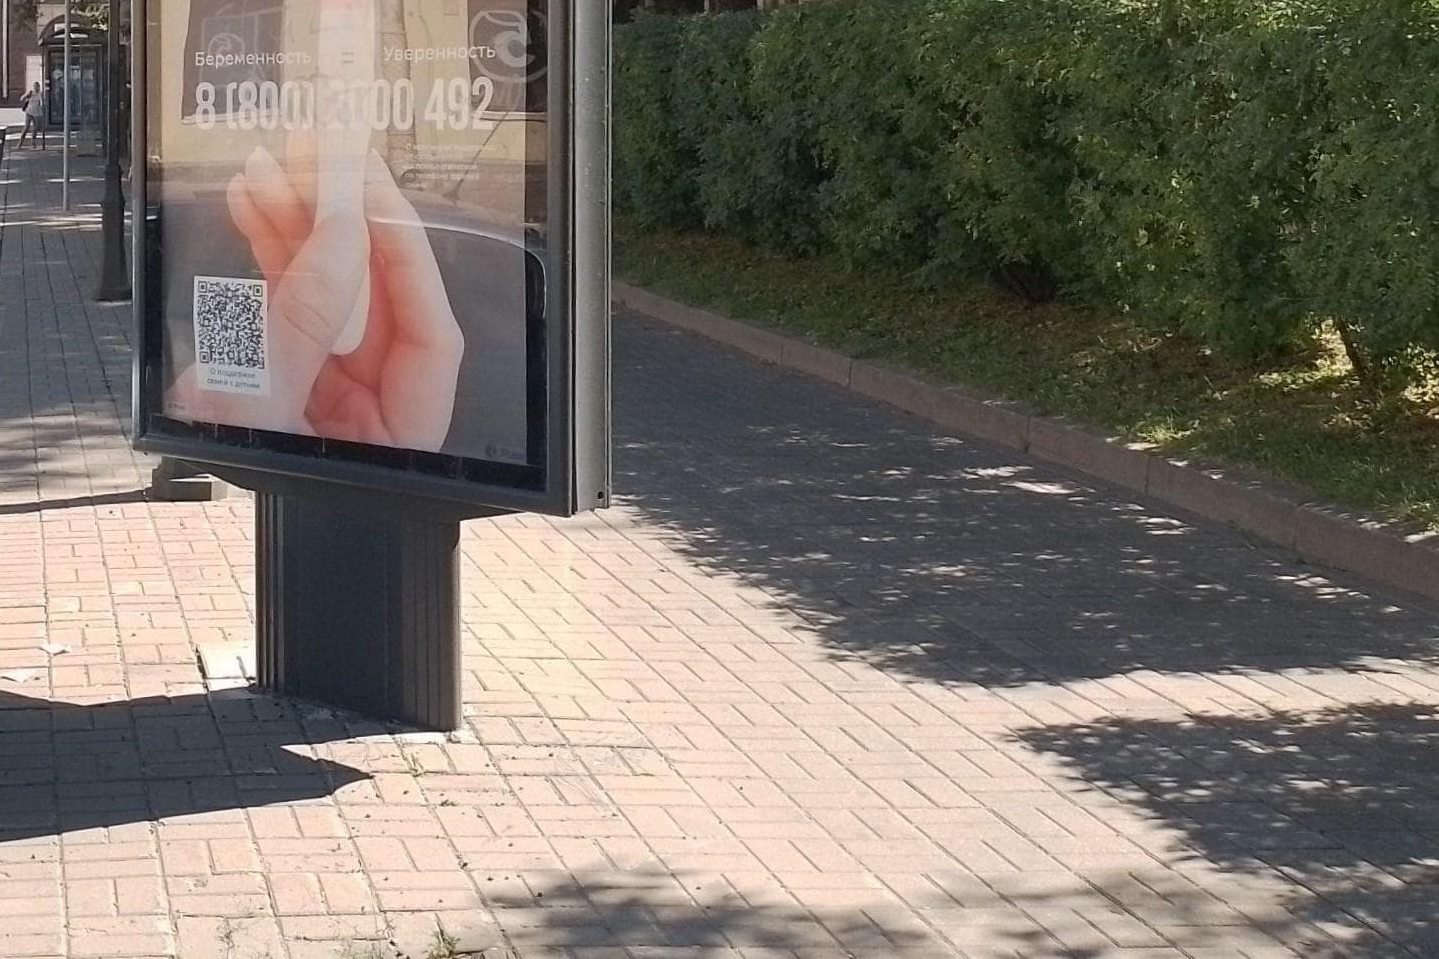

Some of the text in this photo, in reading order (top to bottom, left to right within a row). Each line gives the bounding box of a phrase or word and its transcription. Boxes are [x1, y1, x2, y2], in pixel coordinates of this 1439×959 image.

[194, 50, 312, 69] Беременность
[383, 44, 496, 64] Уверенность
[195, 81, 217, 130] 8
[424, 75, 494, 130] 492
